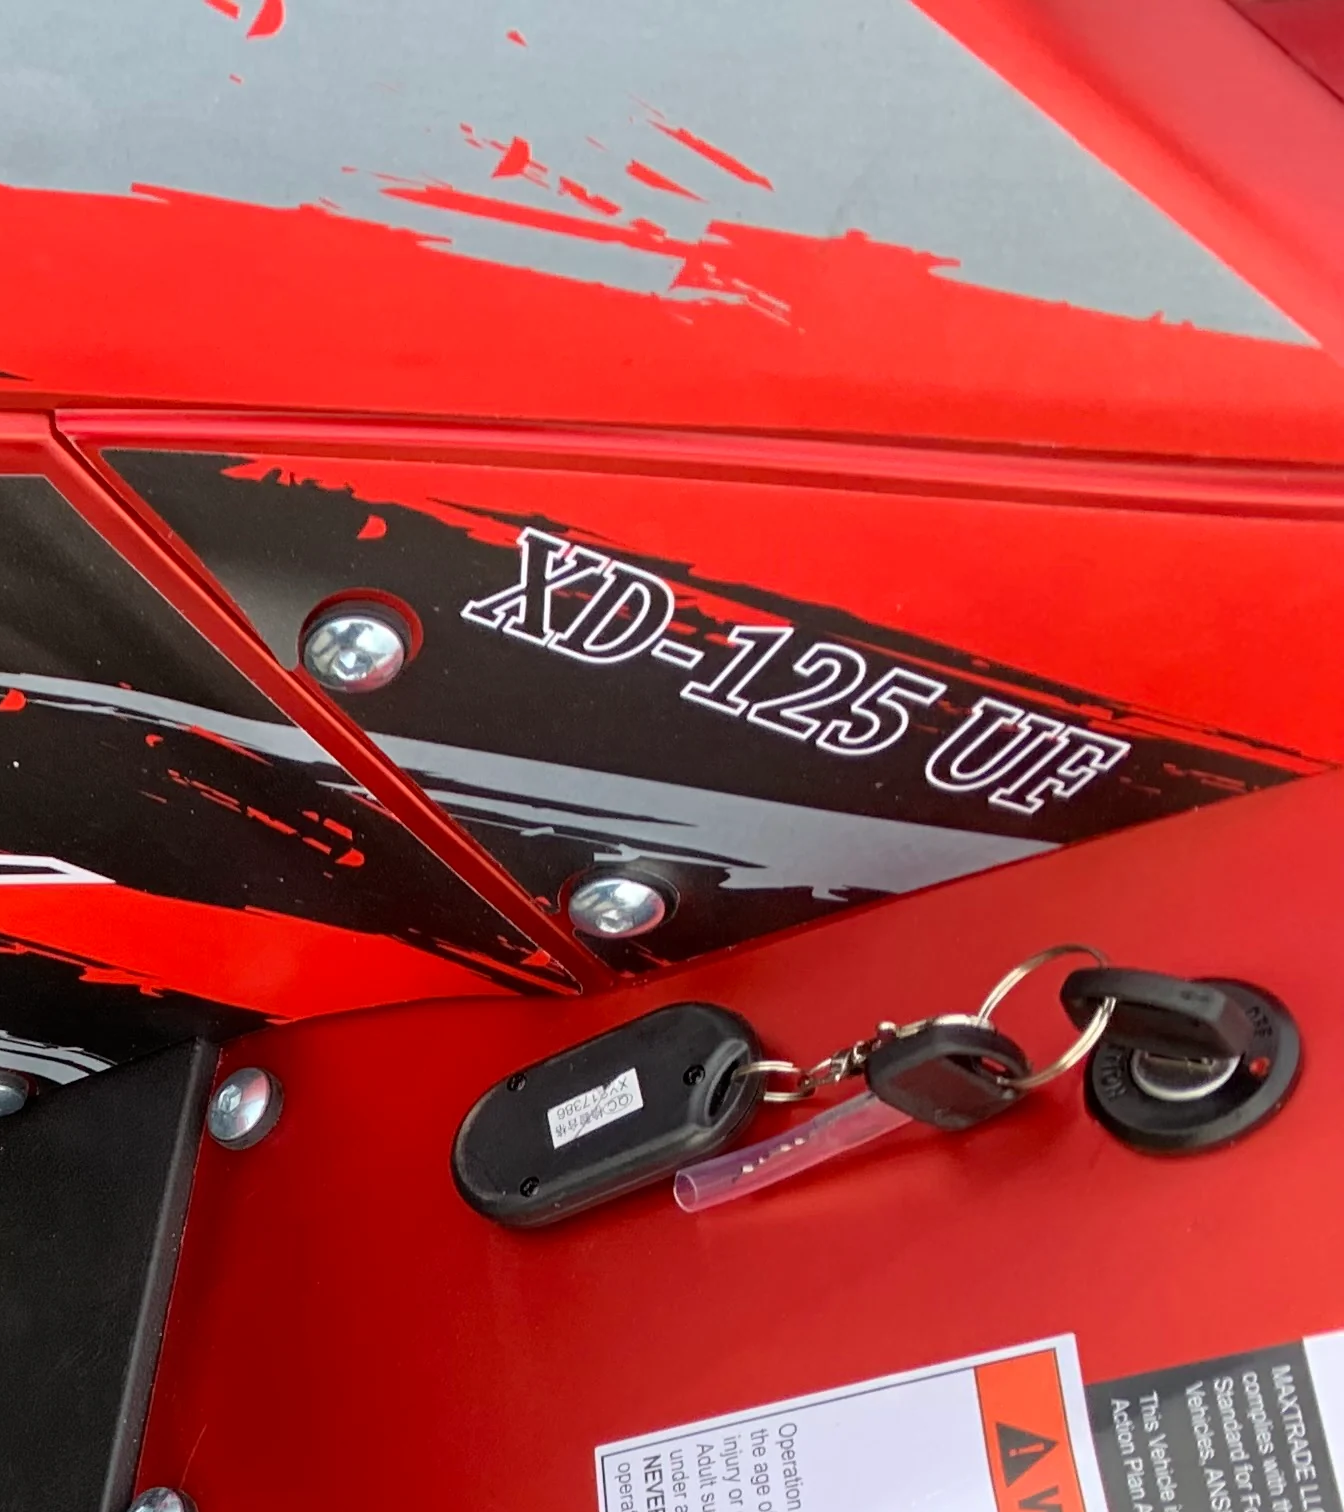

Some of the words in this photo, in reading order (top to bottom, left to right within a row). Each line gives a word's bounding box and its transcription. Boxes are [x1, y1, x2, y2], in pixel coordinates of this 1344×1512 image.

[461, 526, 948, 757] XD-125
[924, 695, 1132, 815] UF
[1111, 1399, 1136, 1455] Action
[1139, 1391, 1162, 1433] This
[1213, 1376, 1250, 1462] Standard
[1234, 1463, 1253, 1490] for
[1242, 1371, 1274, 1454] complies
[1262, 1457, 1287, 1496] with
[1272, 1364, 1317, 1482] MAXTRADE
[696, 1443, 718, 1489] Adult
[719, 1434, 743, 1483] injury
[750, 1428, 769, 1458] the
[775, 1422, 804, 1512] Operation
[1148, 1434, 1178, 1502] Vehicle
[669, 1448, 689, 1499] under
[728, 1488, 744, 1506] or
[750, 1462, 771, 1496] age
[1123, 1457, 1146, 1501] Plan
